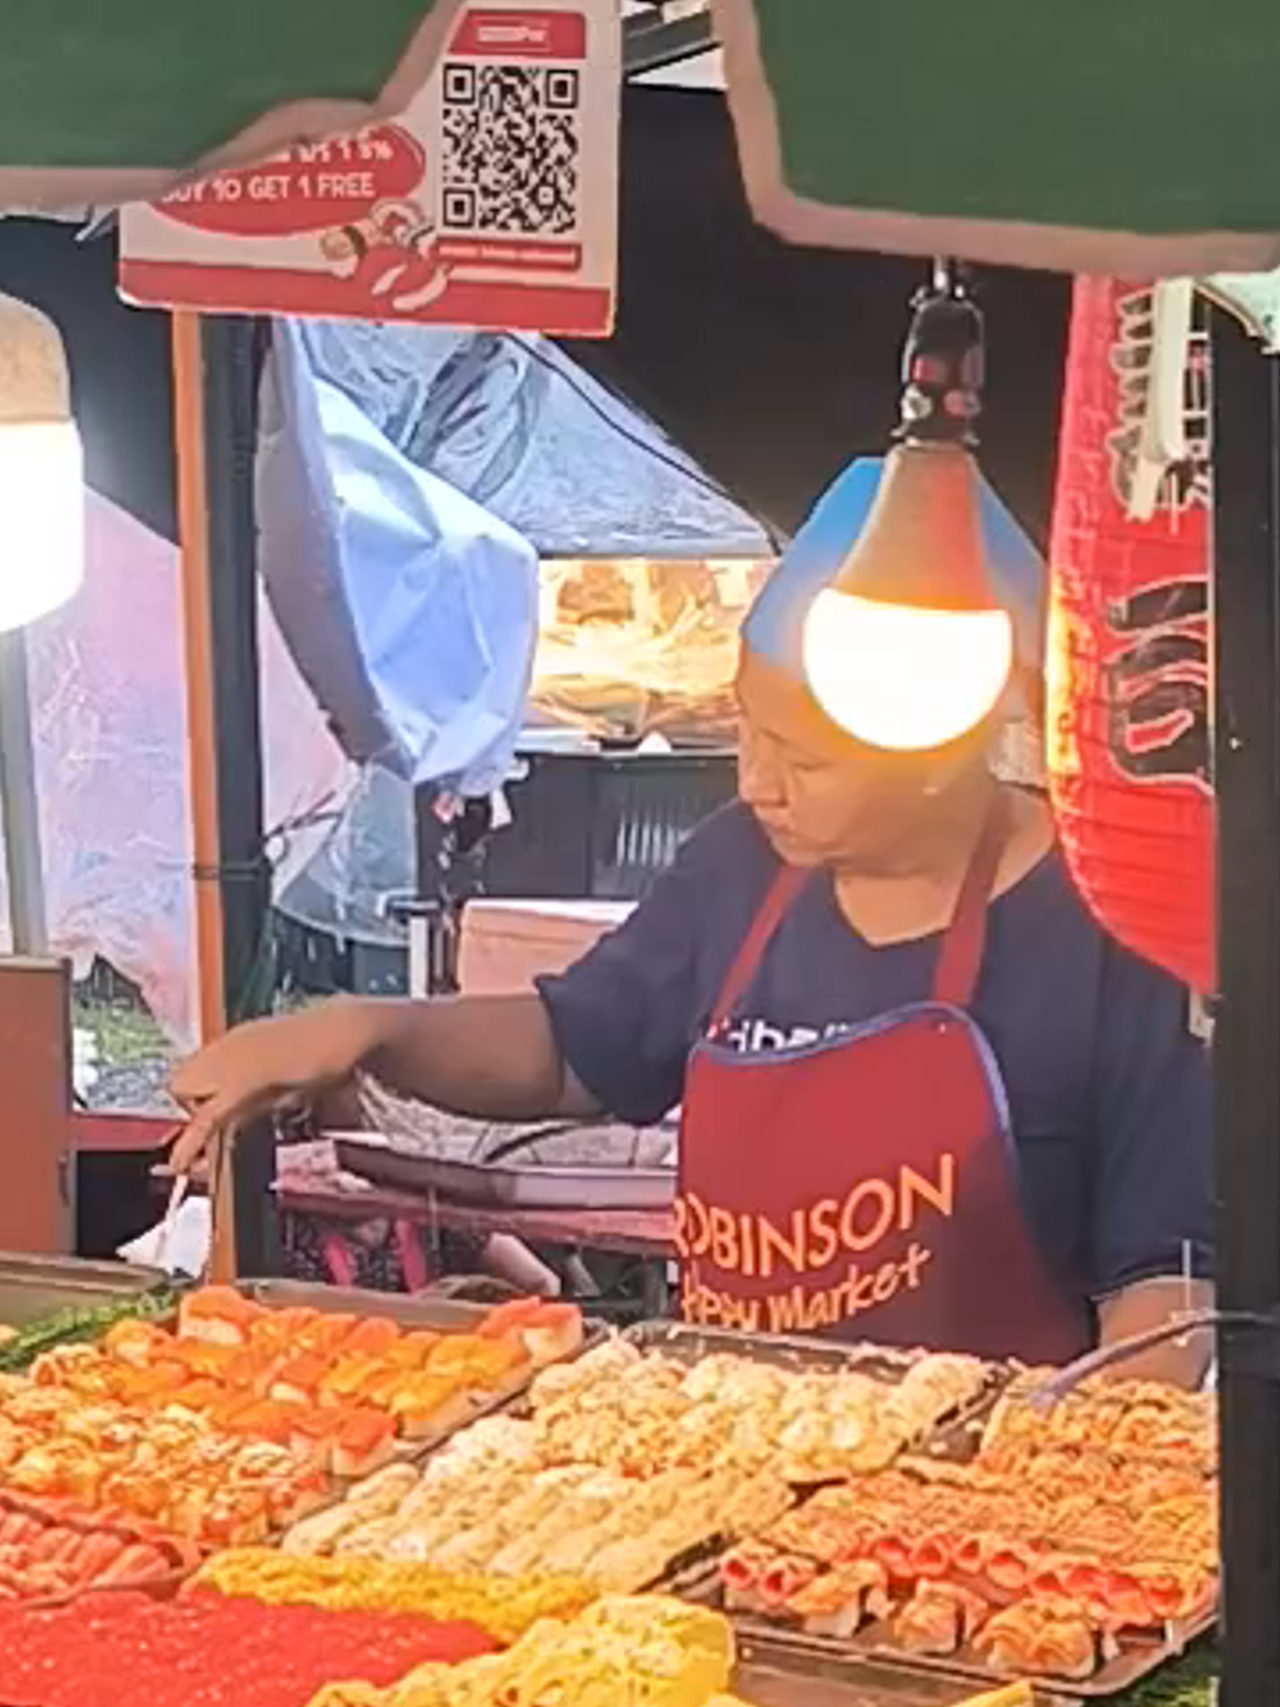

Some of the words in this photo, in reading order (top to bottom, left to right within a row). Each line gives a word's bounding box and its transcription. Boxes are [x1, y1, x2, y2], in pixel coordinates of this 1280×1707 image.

[212, 177, 242, 202] 10
[248, 174, 290, 199] GET
[297, 174, 312, 199] 1
[318, 171, 375, 199] FREE
